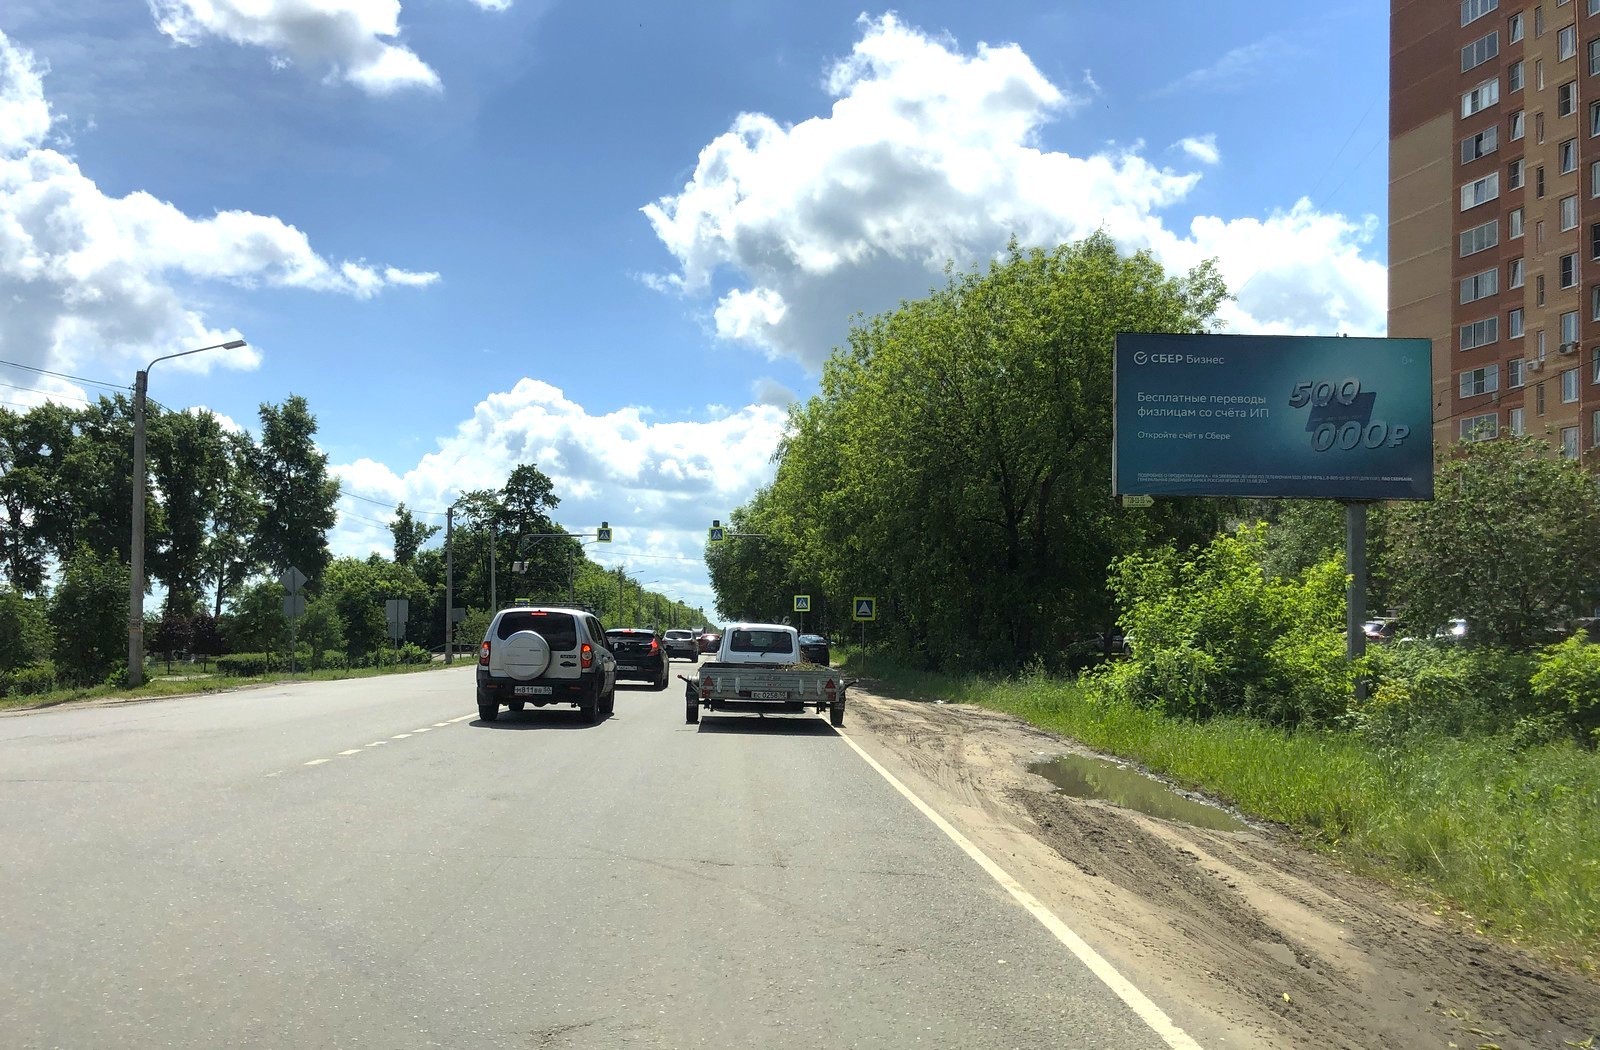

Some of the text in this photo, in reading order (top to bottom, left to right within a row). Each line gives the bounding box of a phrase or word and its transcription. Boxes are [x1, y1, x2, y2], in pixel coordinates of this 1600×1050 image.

[1150, 353, 1225, 365] СБЕР Бизнес
[1137, 391, 1267, 406] Бесплатные переводы
[1288, 377, 1361, 409] 500
[1137, 406, 1269, 419] физлицам со счёта ИП
[1137, 430, 1178, 440] Откройте
[1178, 432, 1197, 440] счёт
[1205, 432, 1231, 441] Сбере
